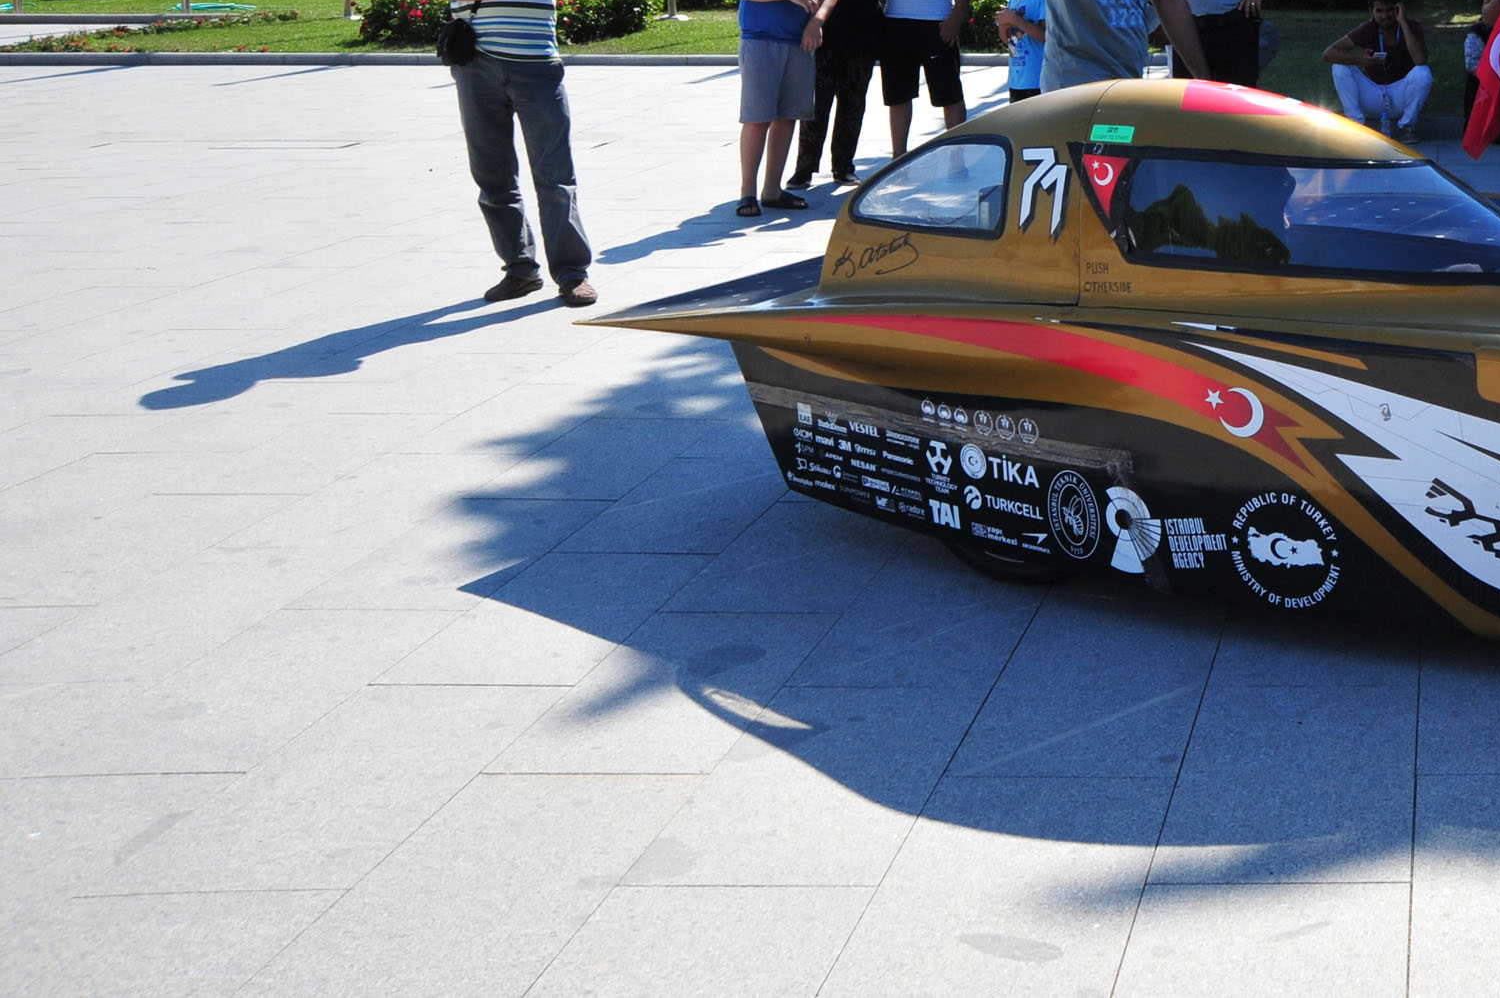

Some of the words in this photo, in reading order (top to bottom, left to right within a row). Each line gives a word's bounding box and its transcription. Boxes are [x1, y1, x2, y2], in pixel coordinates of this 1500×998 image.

[1018, 146, 1071, 244] 71
[1086, 261, 1110, 275] PUSH
[849, 420, 880, 438] VESTEL
[815, 434, 835, 447] mavi
[838, 439, 852, 452] 3M
[882, 450, 915, 465] Panasonic
[988, 455, 1040, 489] TİKA
[814, 480, 836, 491] molex
[925, 477, 958, 491] TECHNOLOGY
[935, 485, 950, 495] TEAM
[928, 499, 961, 530] TAI
[984, 494, 1044, 521] TURKCELL
[1232, 492, 1278, 530] REPUBLIC
[1281, 492, 1297, 505] OF
[1300, 499, 1337, 541] TURKEY
[1164, 517, 1207, 535] ISTANBUL
[987, 533, 1018, 546] merkezi
[1168, 534, 1227, 552] DEVELOPMENT
[1172, 552, 1205, 569] AGENCY
[1231, 551, 1267, 596] MINISTRY
[1268, 593, 1282, 605] OF
[1284, 563, 1341, 609] DEVELOPMENT
